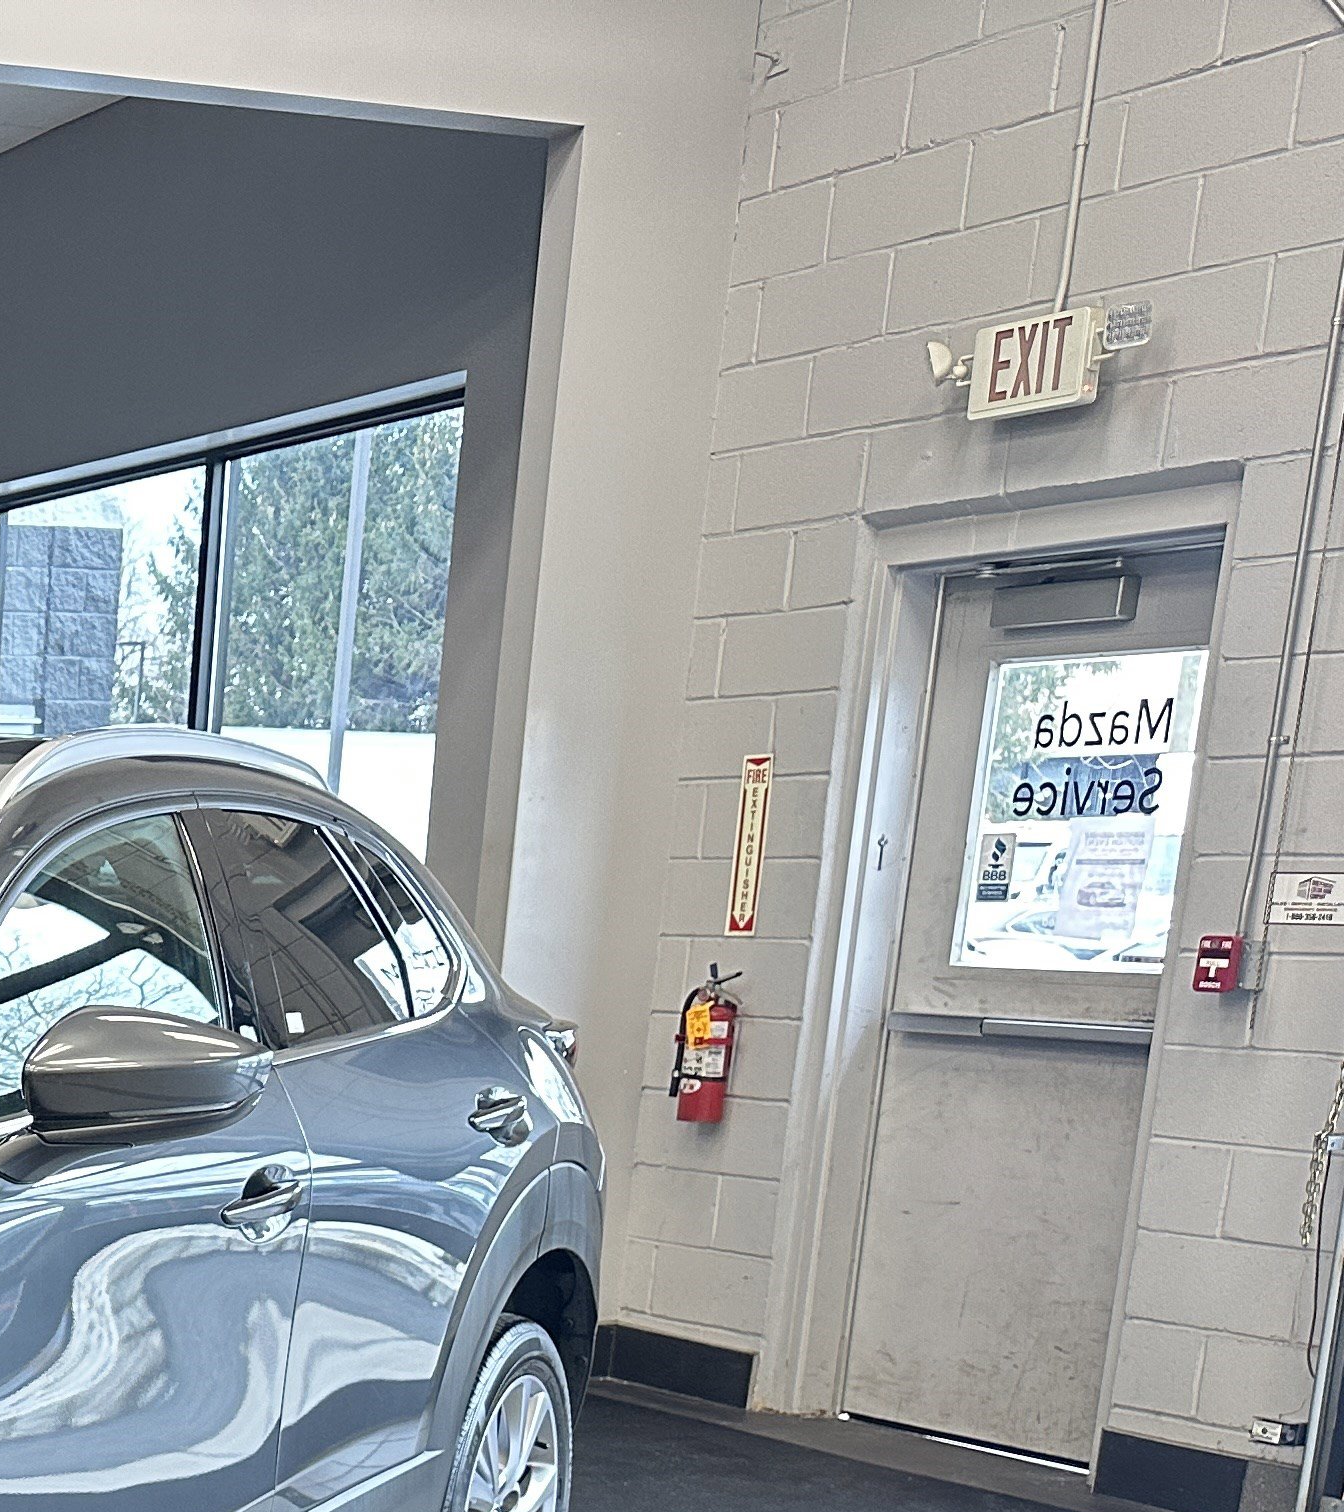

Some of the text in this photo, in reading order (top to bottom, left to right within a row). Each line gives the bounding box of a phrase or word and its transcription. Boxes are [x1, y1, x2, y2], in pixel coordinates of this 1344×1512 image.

[988, 316, 1073, 403] EXIT
[746, 768, 768, 784] FIRE
[739, 787, 759, 922] EXTINGUISHER
[982, 871, 1007, 881] BBB
